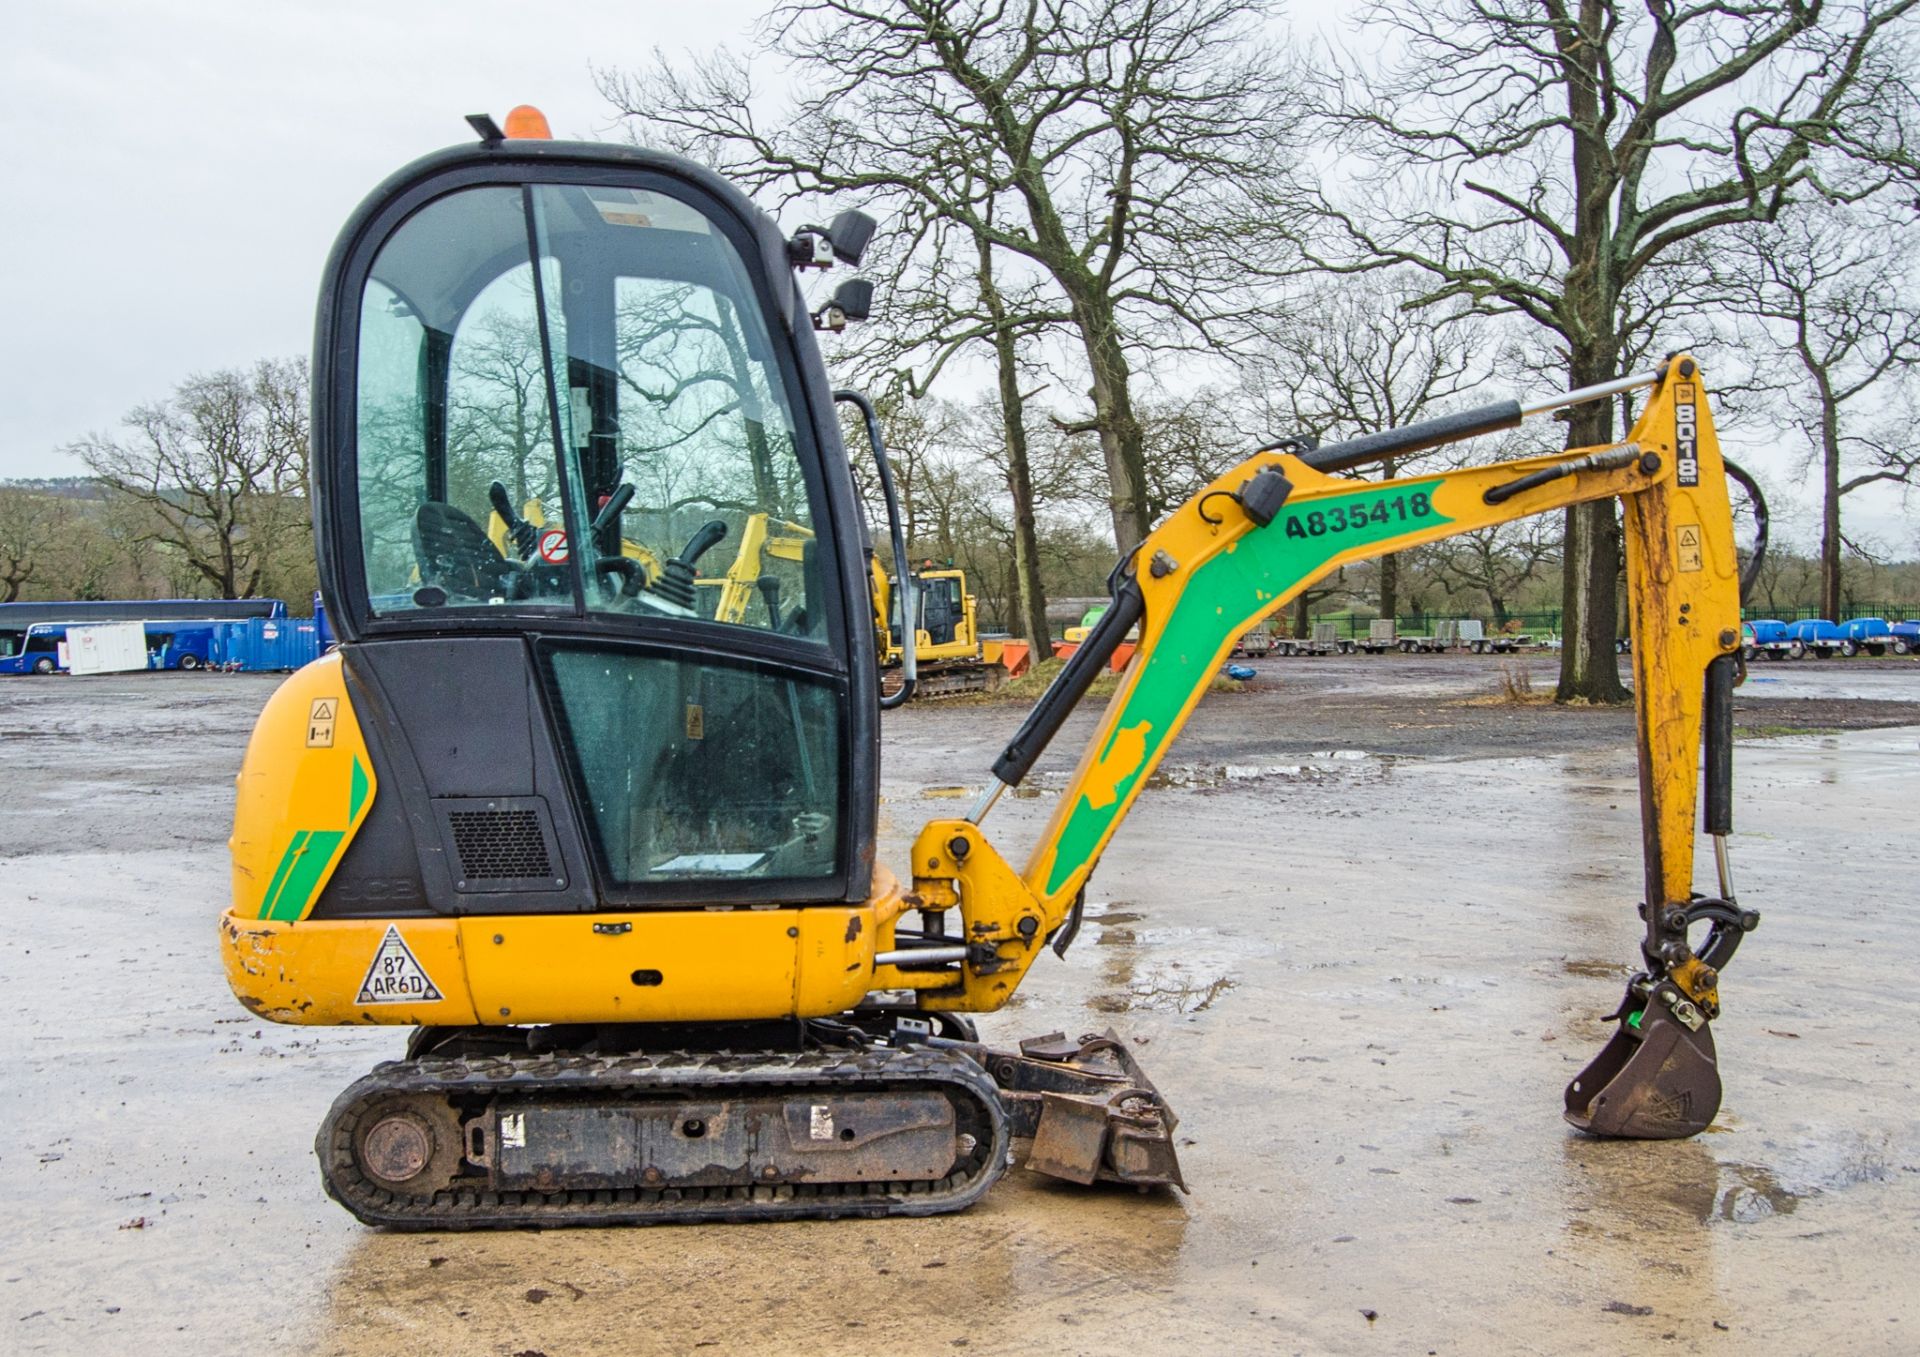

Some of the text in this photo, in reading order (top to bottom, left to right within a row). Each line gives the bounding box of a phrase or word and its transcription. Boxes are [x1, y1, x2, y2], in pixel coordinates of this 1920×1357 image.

[1675, 404, 1697, 476] 8018
[1285, 492, 1431, 540] A835418
[383, 956, 406, 975] 87
[374, 976, 423, 995] AR6D
